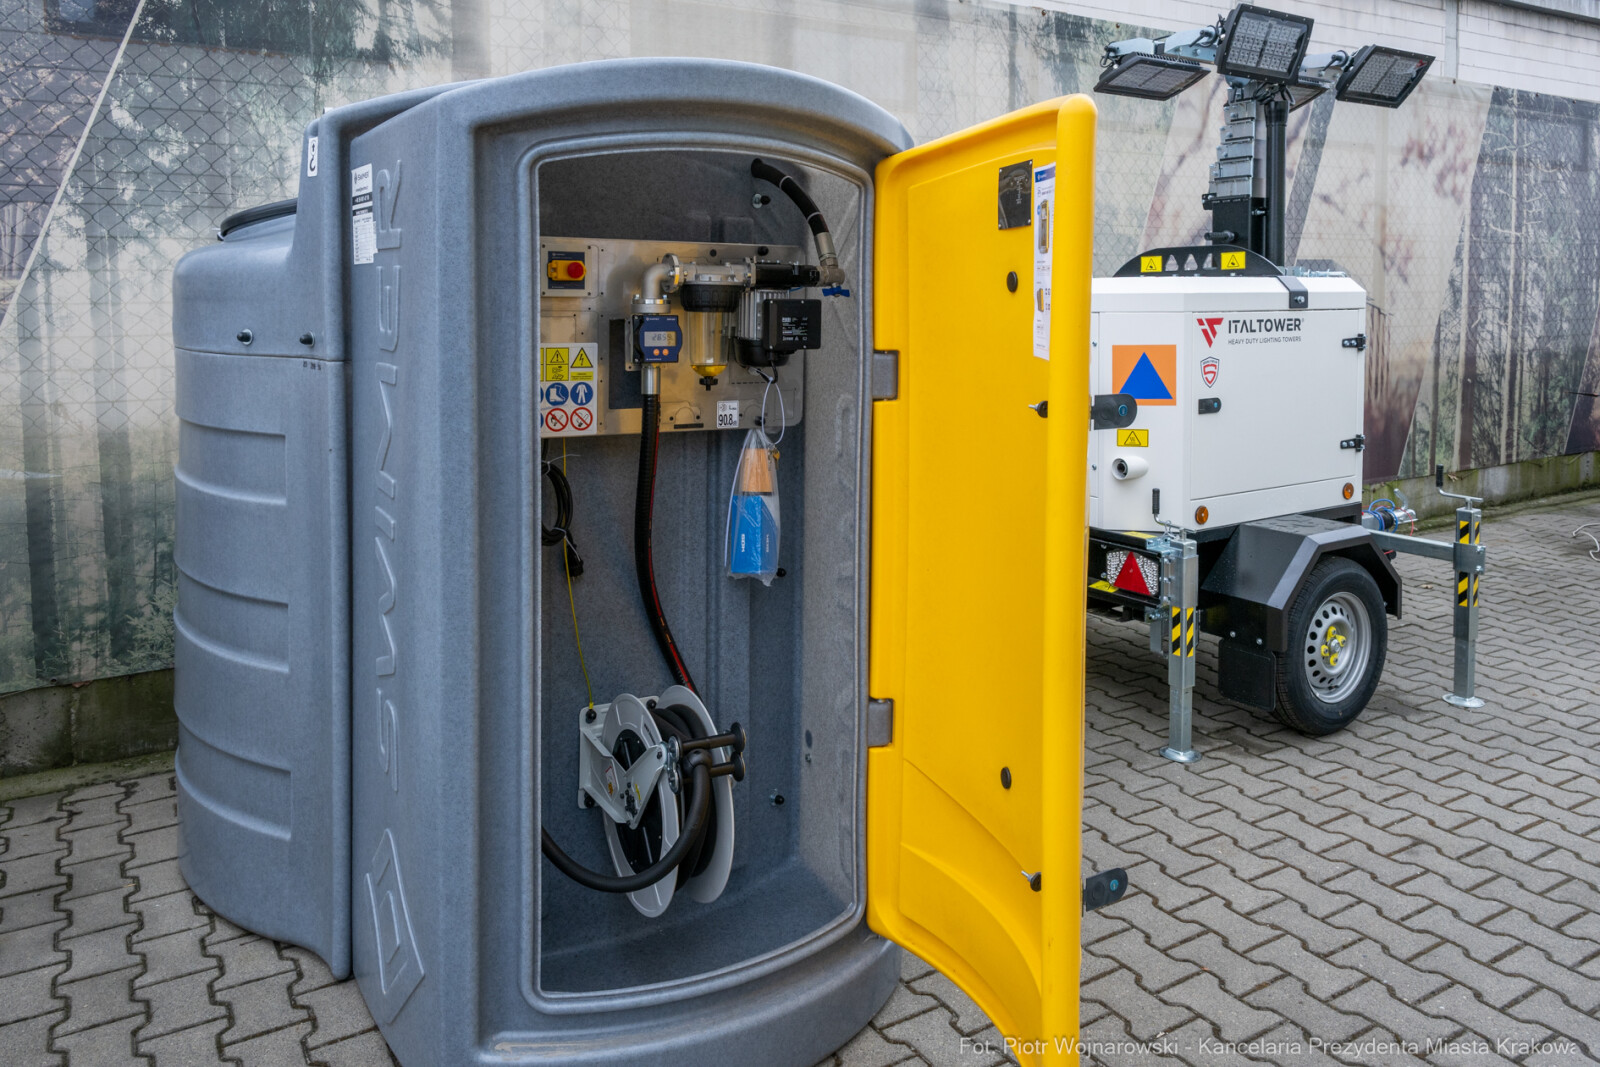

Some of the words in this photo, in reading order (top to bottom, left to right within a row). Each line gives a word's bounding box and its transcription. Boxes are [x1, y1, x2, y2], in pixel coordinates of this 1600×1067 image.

[1228, 318, 1302, 334] ITALTOWER
[718, 413, 734, 426] 90.8
[373, 159, 402, 792] SWIMER
